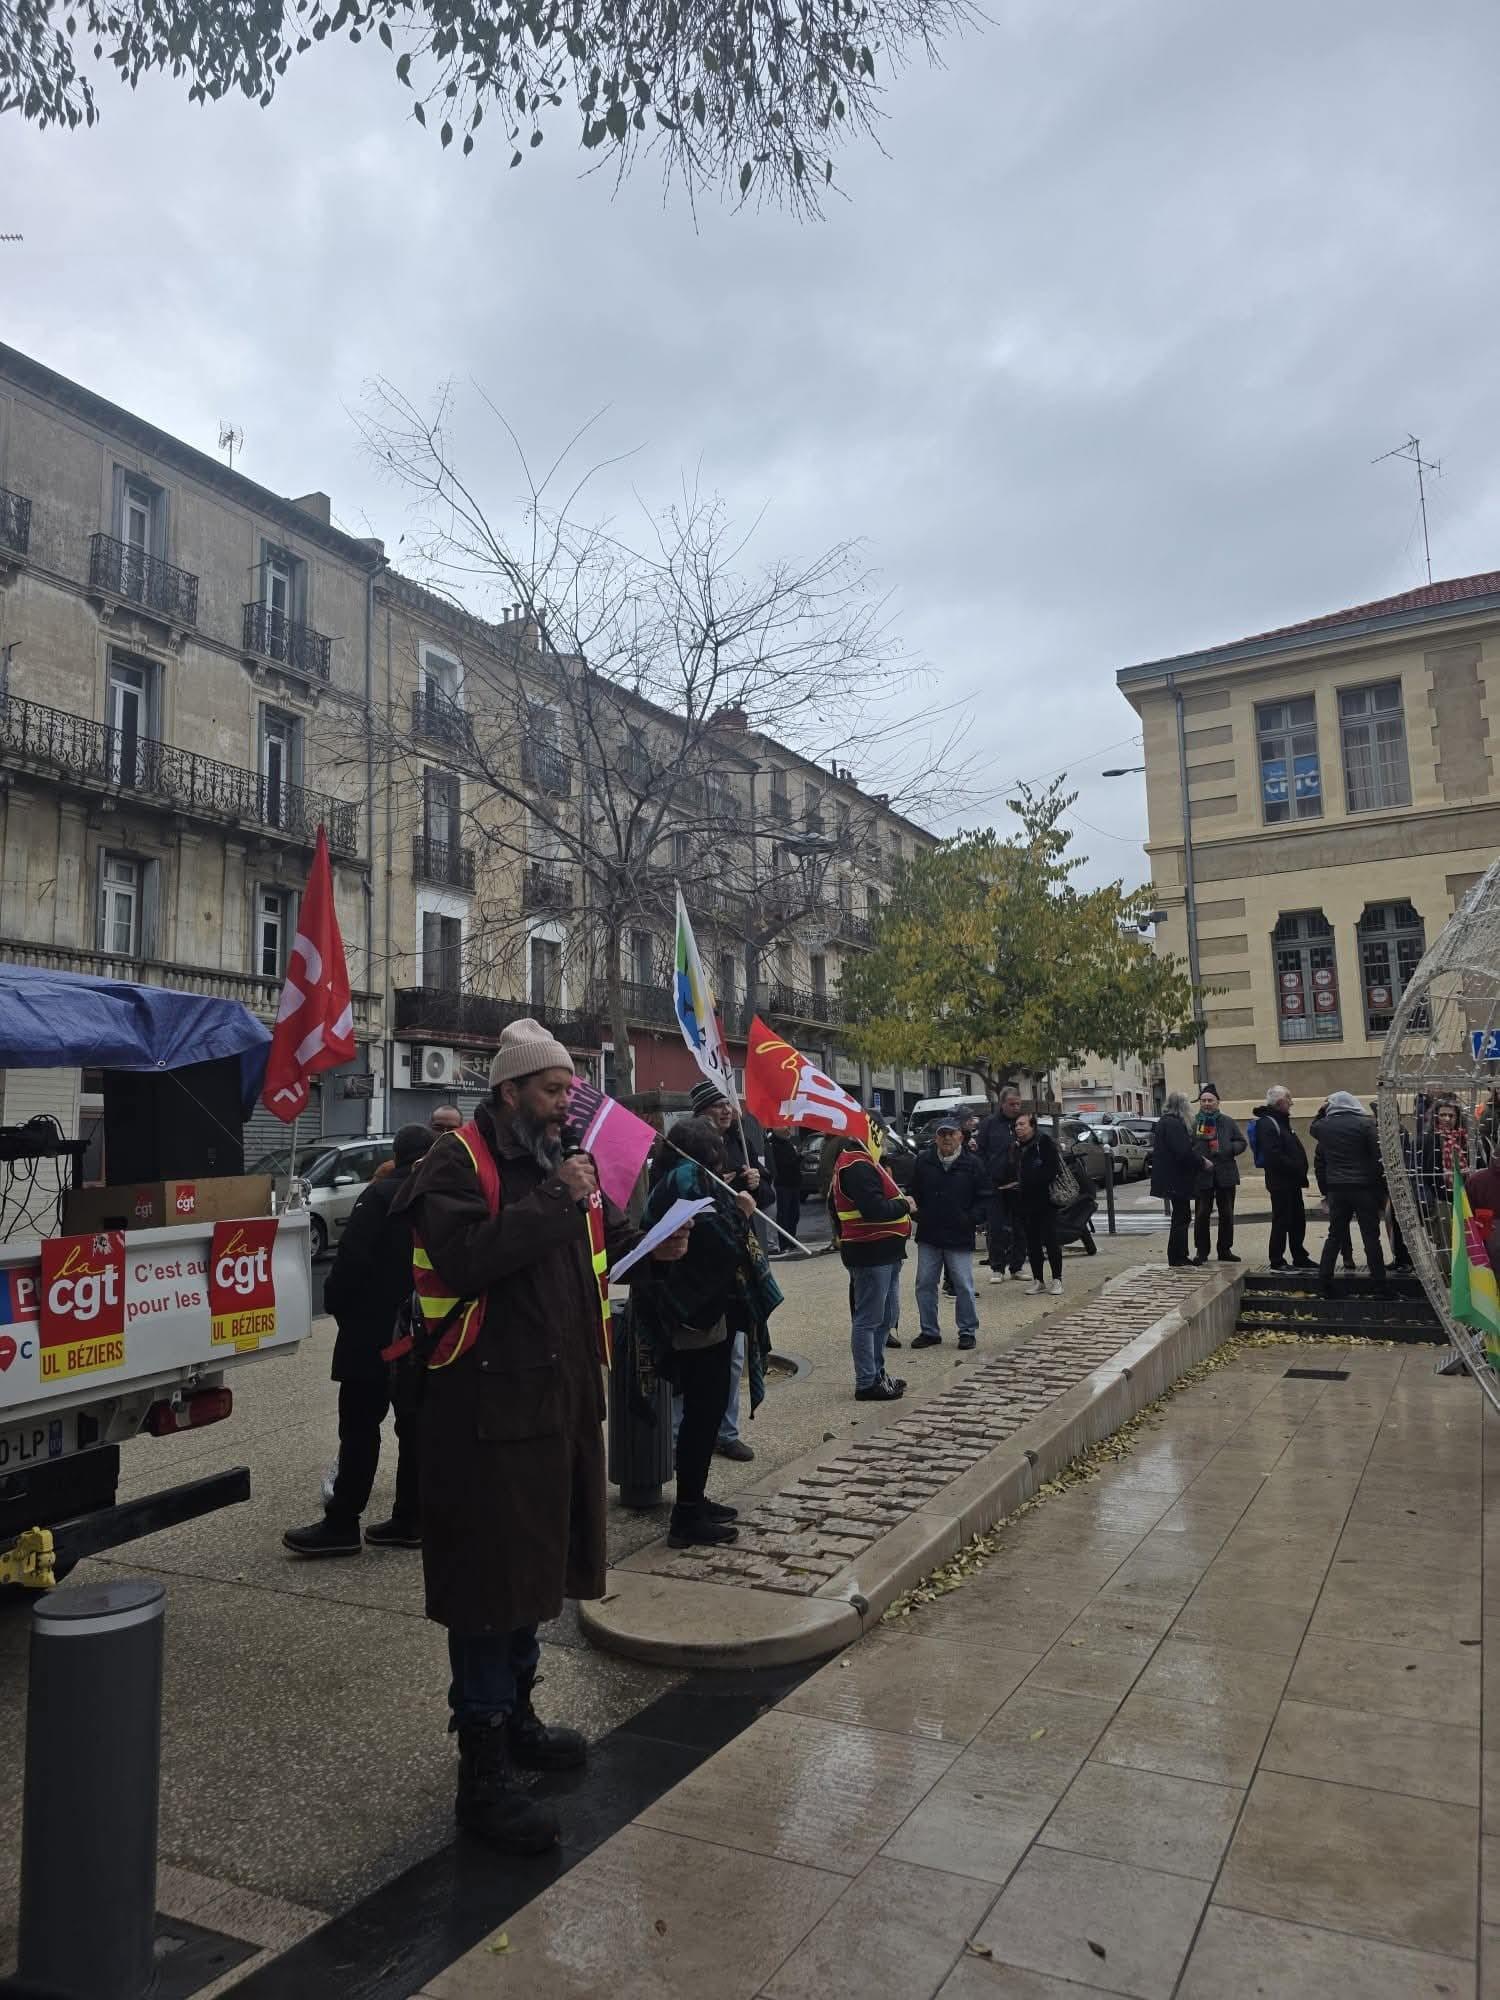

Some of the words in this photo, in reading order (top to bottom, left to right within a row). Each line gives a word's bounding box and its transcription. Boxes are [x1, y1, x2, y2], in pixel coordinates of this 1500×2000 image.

[176, 1195, 196, 1212] cgt
[215, 1246, 269, 1295] cgt
[48, 1263, 119, 1321] cgt
[126, 1296, 171, 1322] pour
[174, 1290, 202, 1309] les
[212, 1320, 227, 1341] UL
[231, 1311, 275, 1338] BÉZIERS
[42, 1353, 61, 1376] UL
[67, 1339, 124, 1371] BÉZIERS
